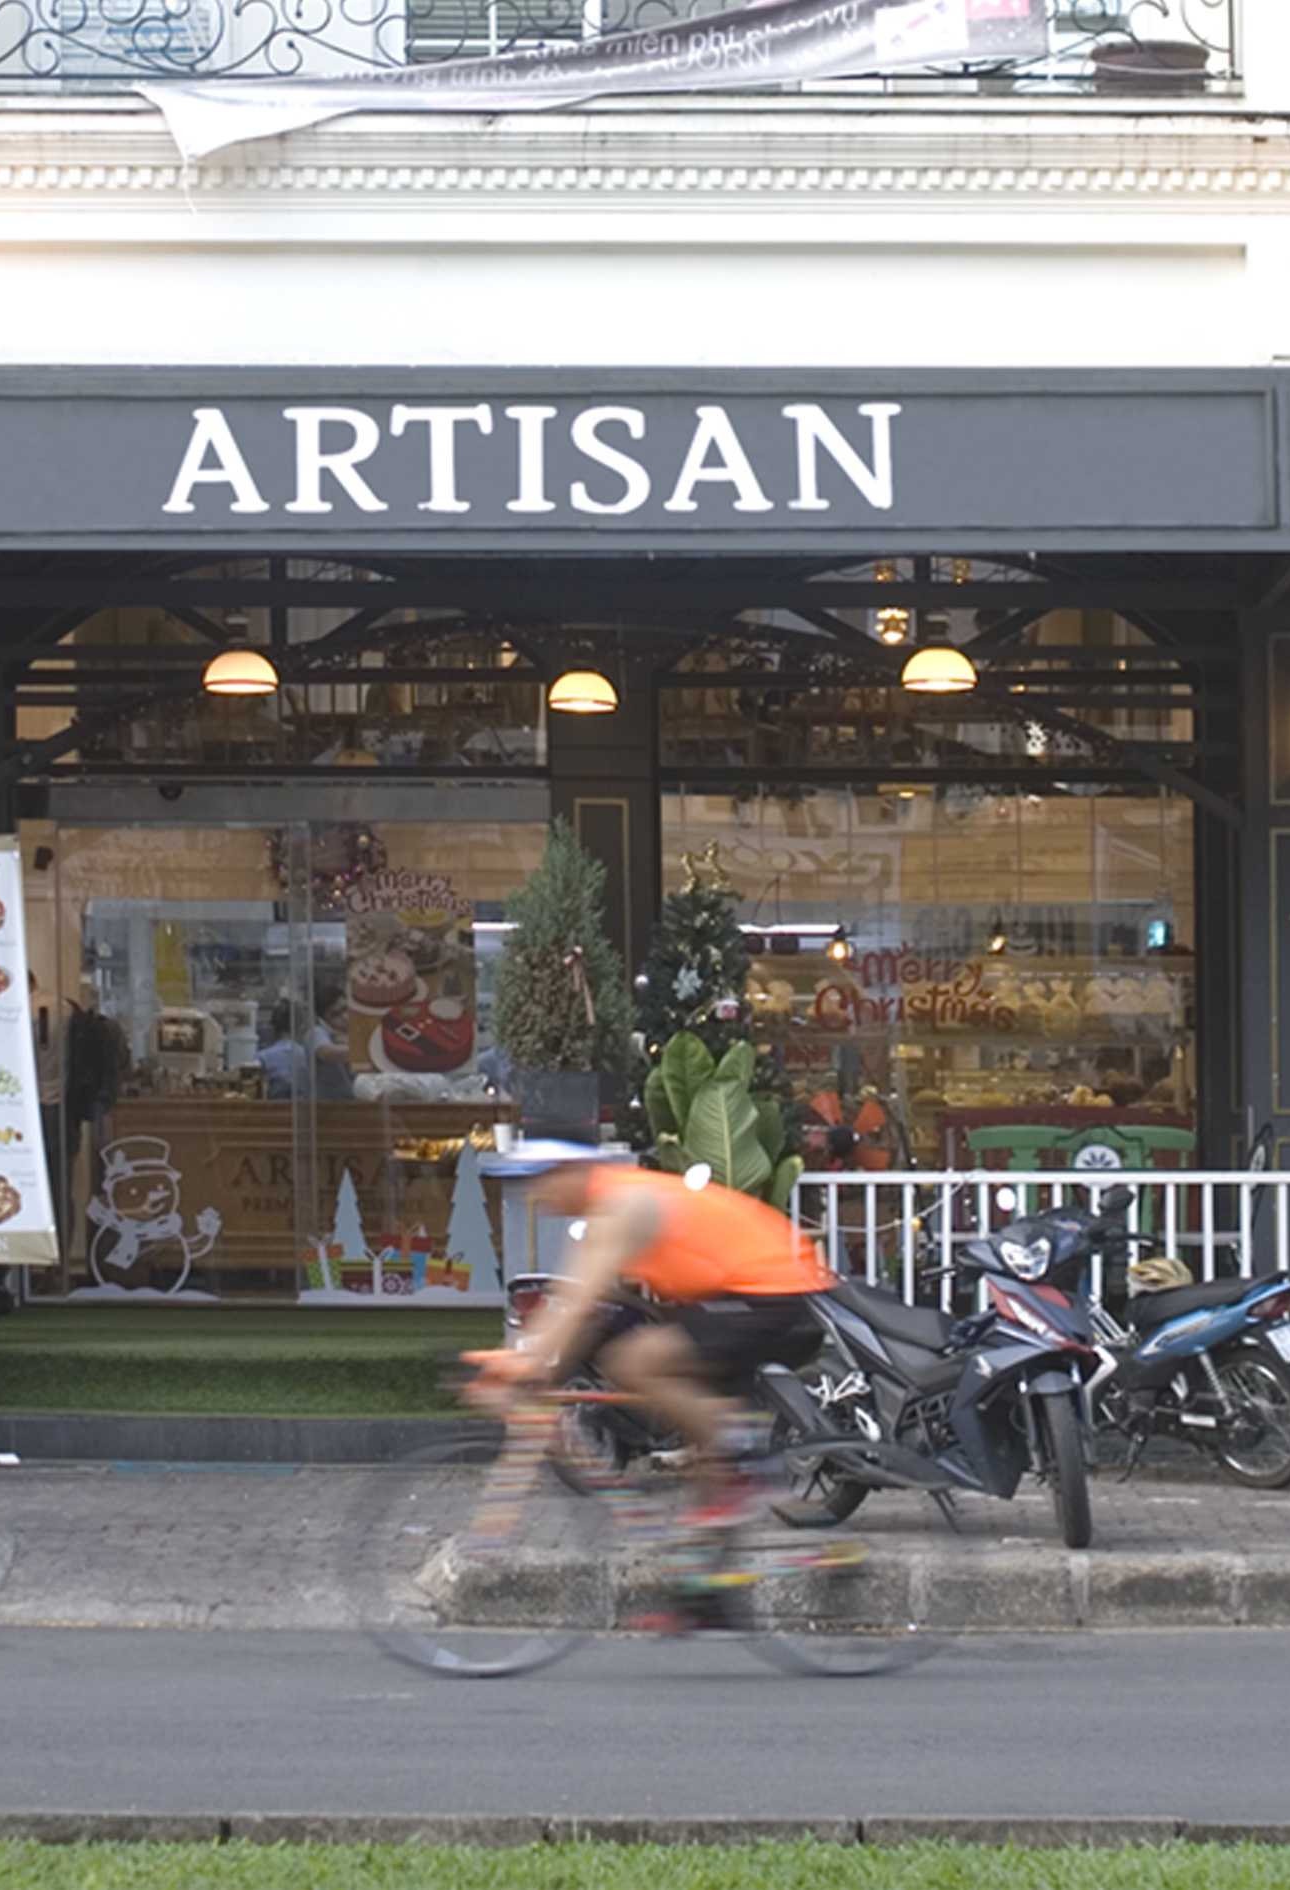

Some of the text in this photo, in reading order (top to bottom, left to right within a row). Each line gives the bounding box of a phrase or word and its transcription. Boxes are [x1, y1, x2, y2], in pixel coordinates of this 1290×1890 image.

[162, 403, 901, 515] ARTISAN
[346, 888, 474, 916] Christmas
[375, 865, 454, 895] Merry
[842, 941, 984, 998] Merry
[814, 985, 1015, 1031] Christmas
